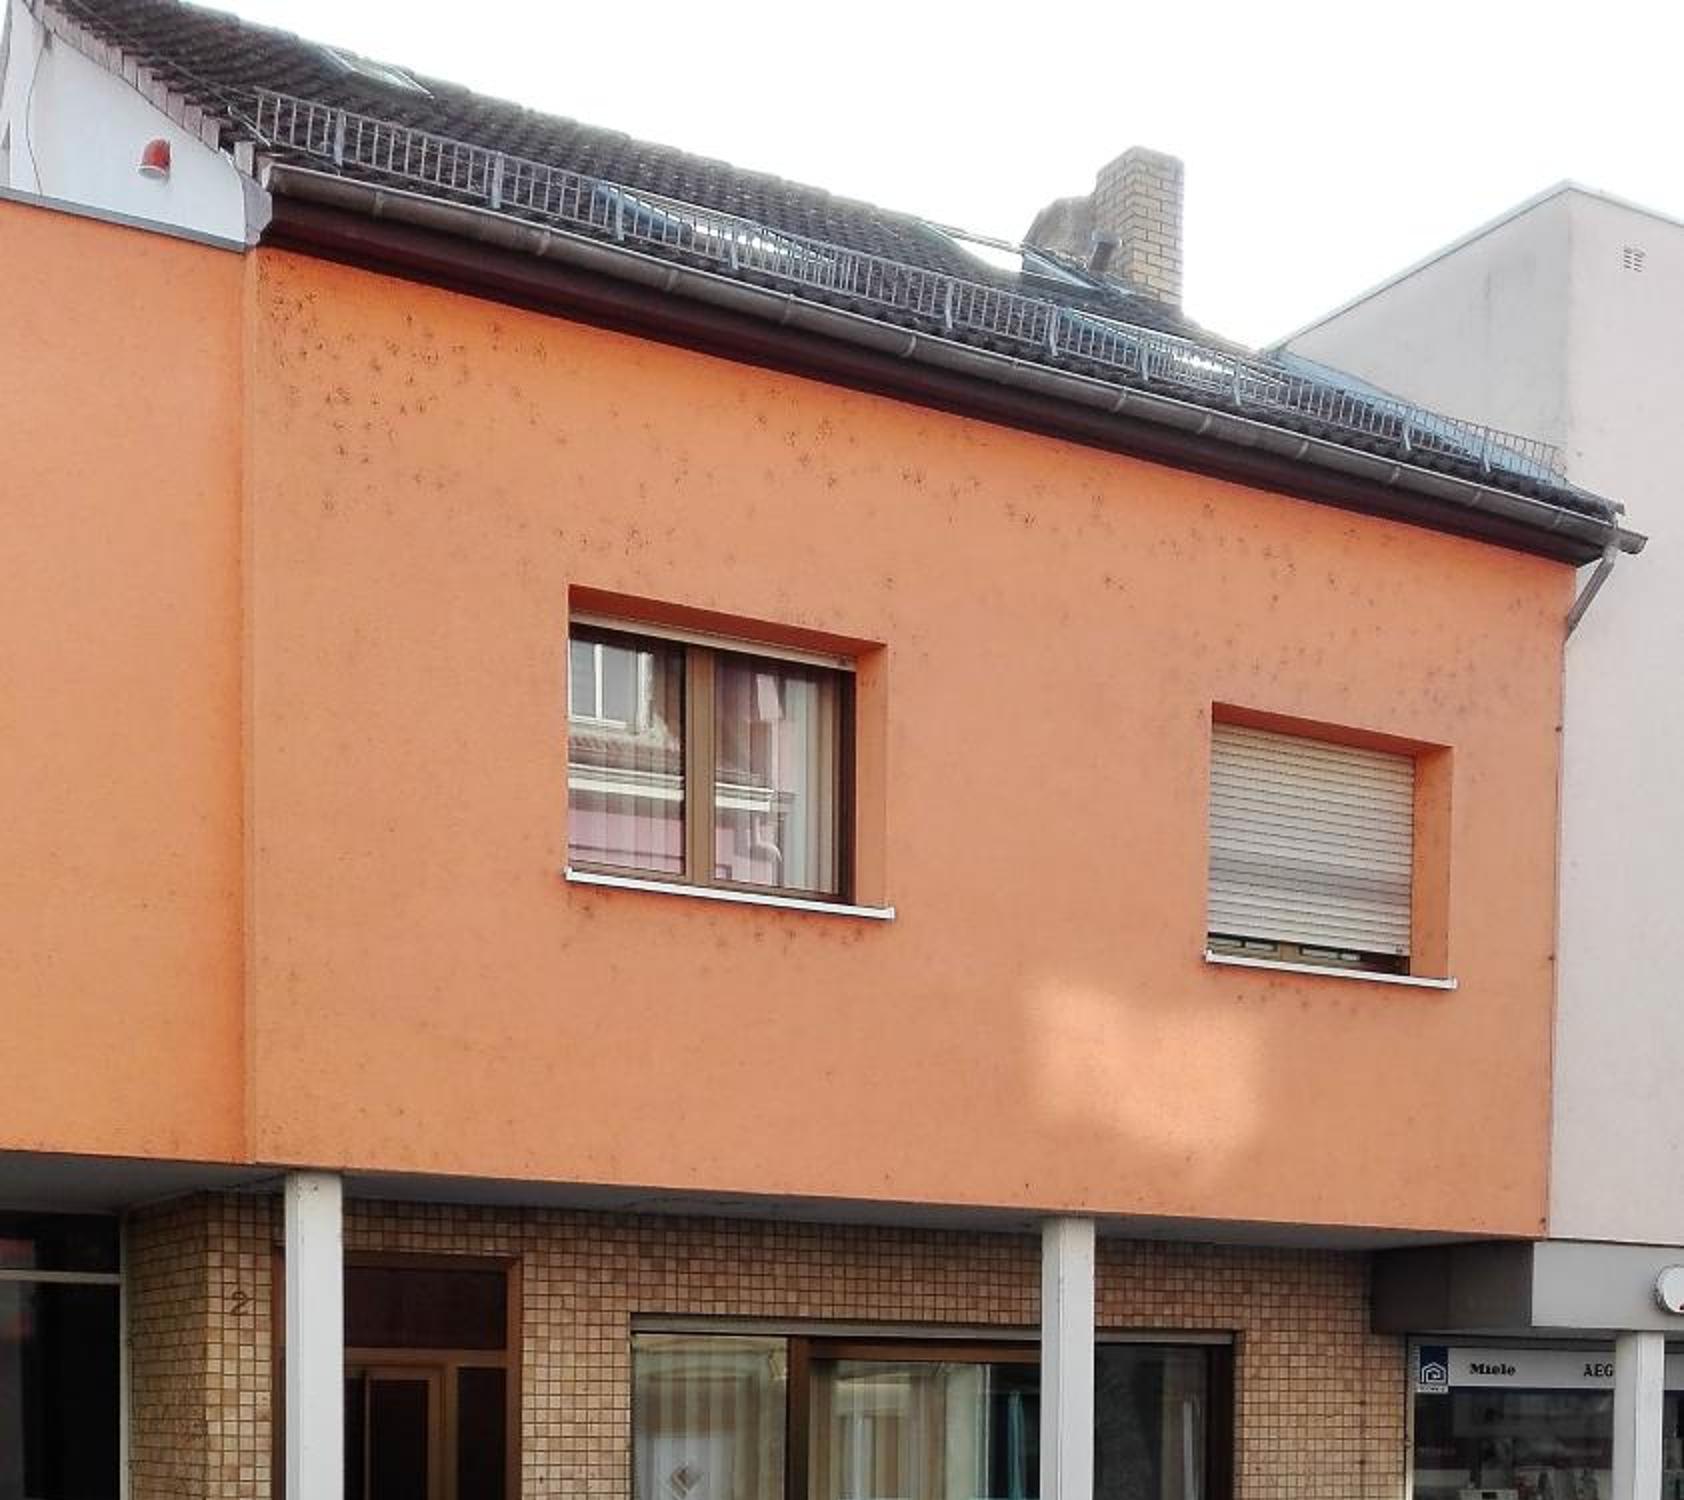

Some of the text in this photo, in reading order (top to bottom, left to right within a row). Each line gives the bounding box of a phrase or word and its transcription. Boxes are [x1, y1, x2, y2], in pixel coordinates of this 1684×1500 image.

[230, 1291, 249, 1316] 2
[1469, 1363, 1516, 1377] Miele
[1583, 1363, 1614, 1378] AEG
